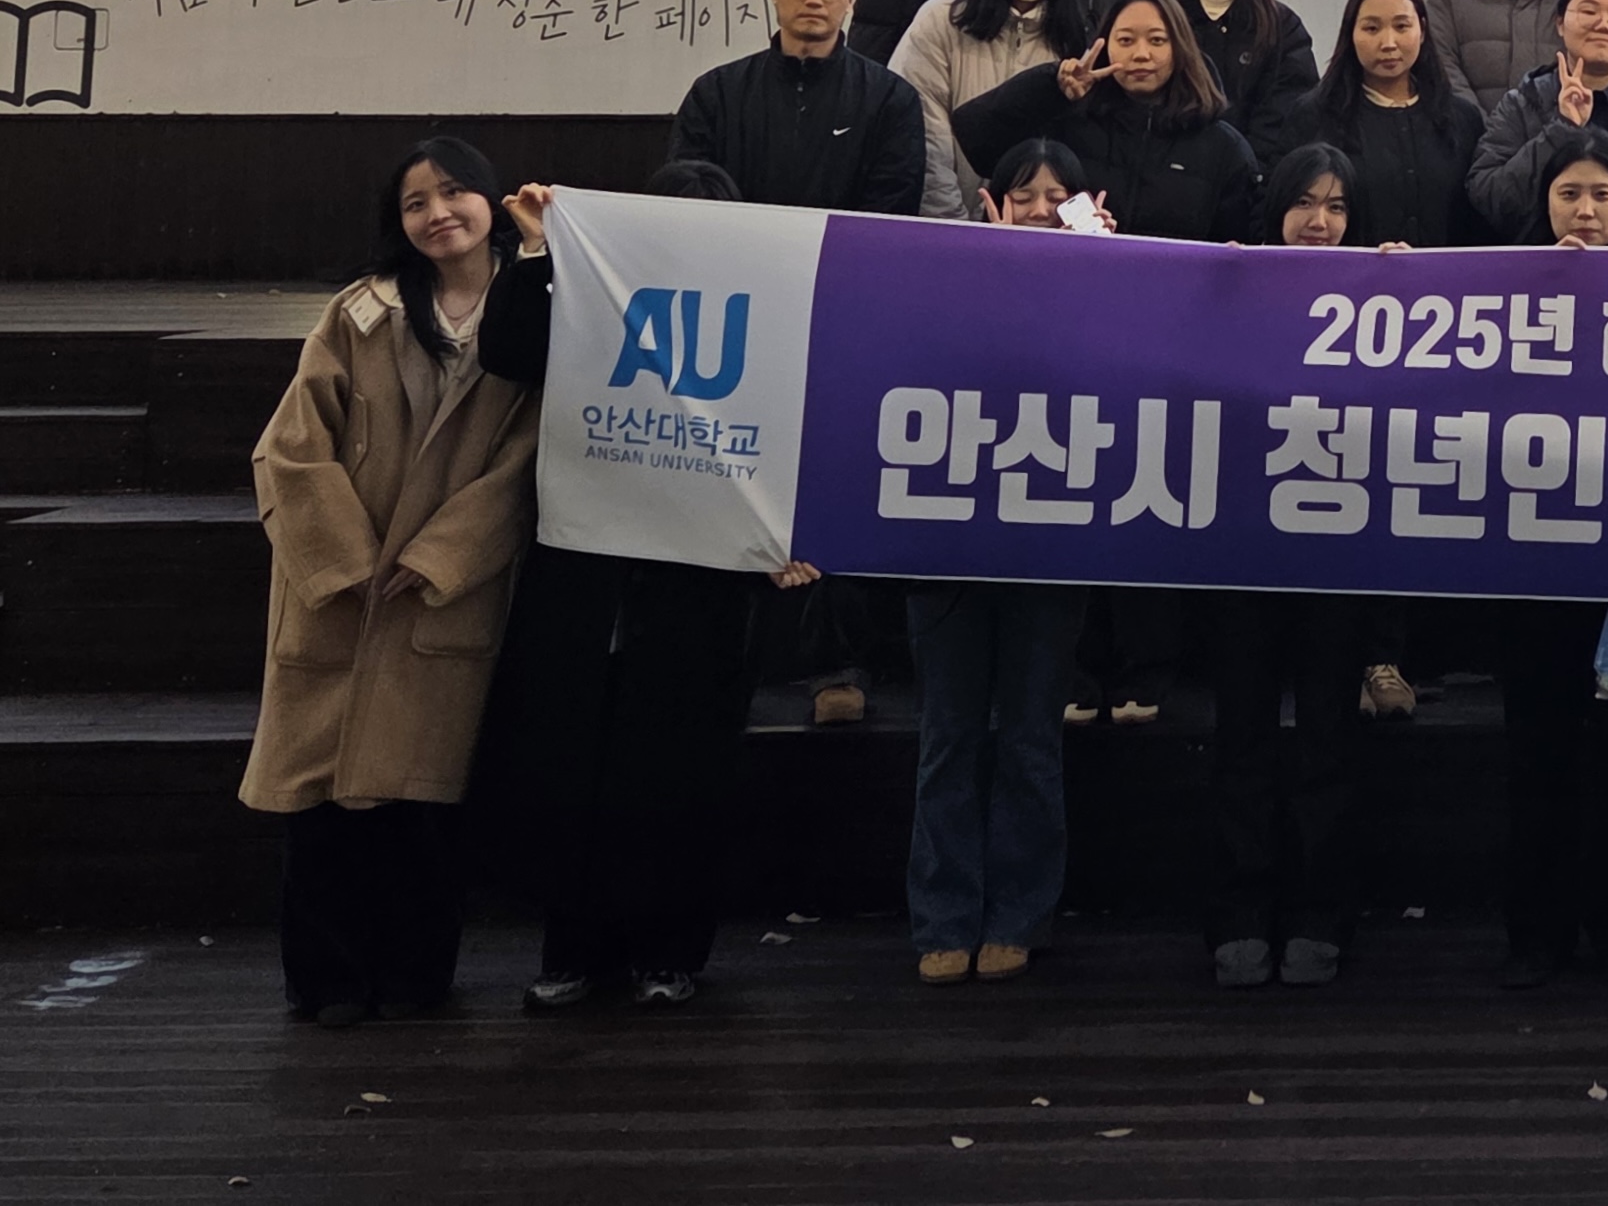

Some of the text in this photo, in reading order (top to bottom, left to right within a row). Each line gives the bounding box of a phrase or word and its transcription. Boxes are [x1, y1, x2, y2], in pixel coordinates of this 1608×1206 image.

[607, 287, 751, 401] AU
[1302, 293, 1576, 377] 2025년
[582, 404, 762, 457] 안산대학교
[584, 444, 758, 482] ANSAN UNIVERSITY
[877, 386, 1222, 530] 안산시
